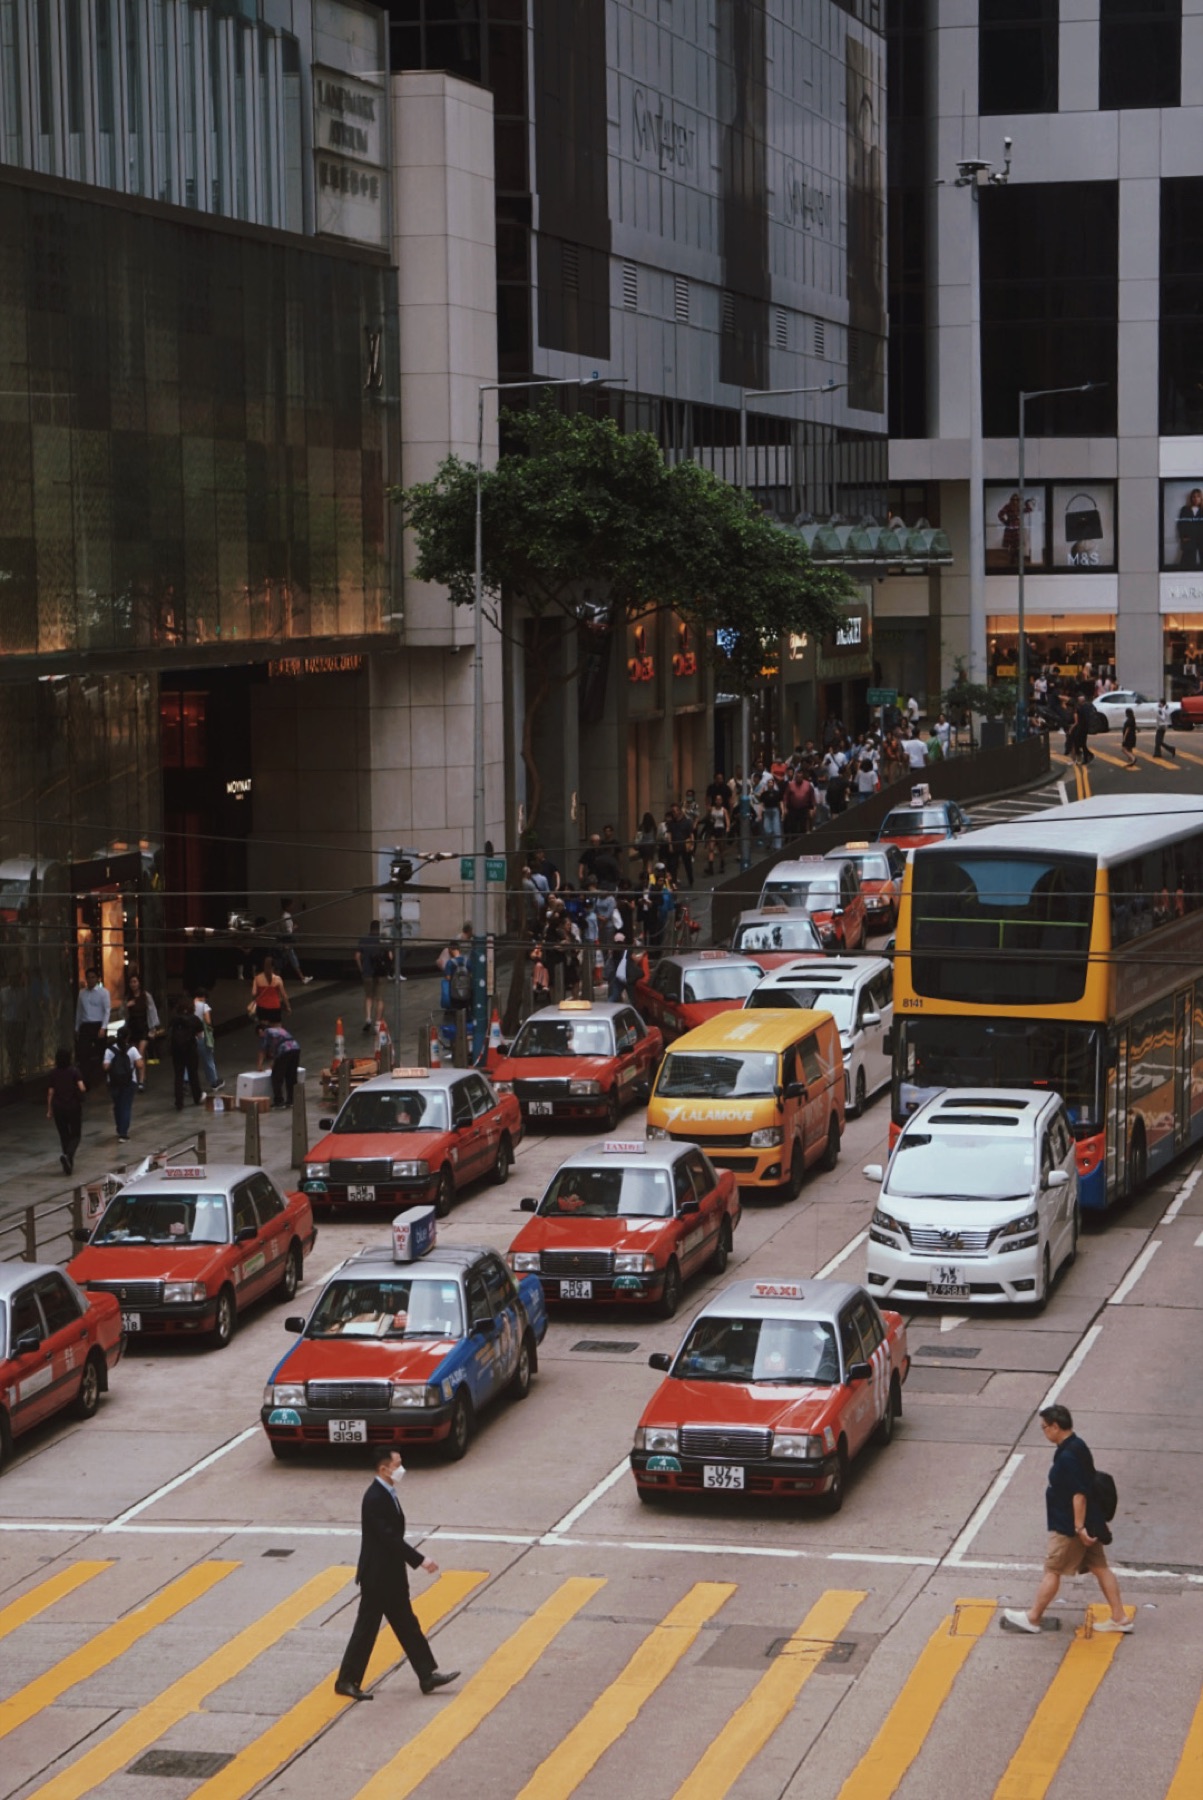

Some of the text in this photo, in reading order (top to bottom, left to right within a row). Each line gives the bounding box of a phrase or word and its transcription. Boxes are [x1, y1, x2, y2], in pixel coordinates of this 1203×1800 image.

[633, 89, 695, 171] SAINT LAURENT
[1067, 552, 1100, 566] M&S
[226, 779, 252, 793] MOYNAT
[903, 999, 923, 1008] 8141
[681, 1109, 753, 1122] LALAMOVE
[165, 1168, 201, 1177] TAXI
[940, 1273, 957, 1284] 712
[561, 1289, 590, 1298] 2044
[756, 1285, 797, 1296] TAXI
[339, 1420, 356, 1431] DF
[333, 1431, 362, 1442] 3138
[715, 1466, 732, 1477] UZ
[708, 1476, 742, 1488] 5975
